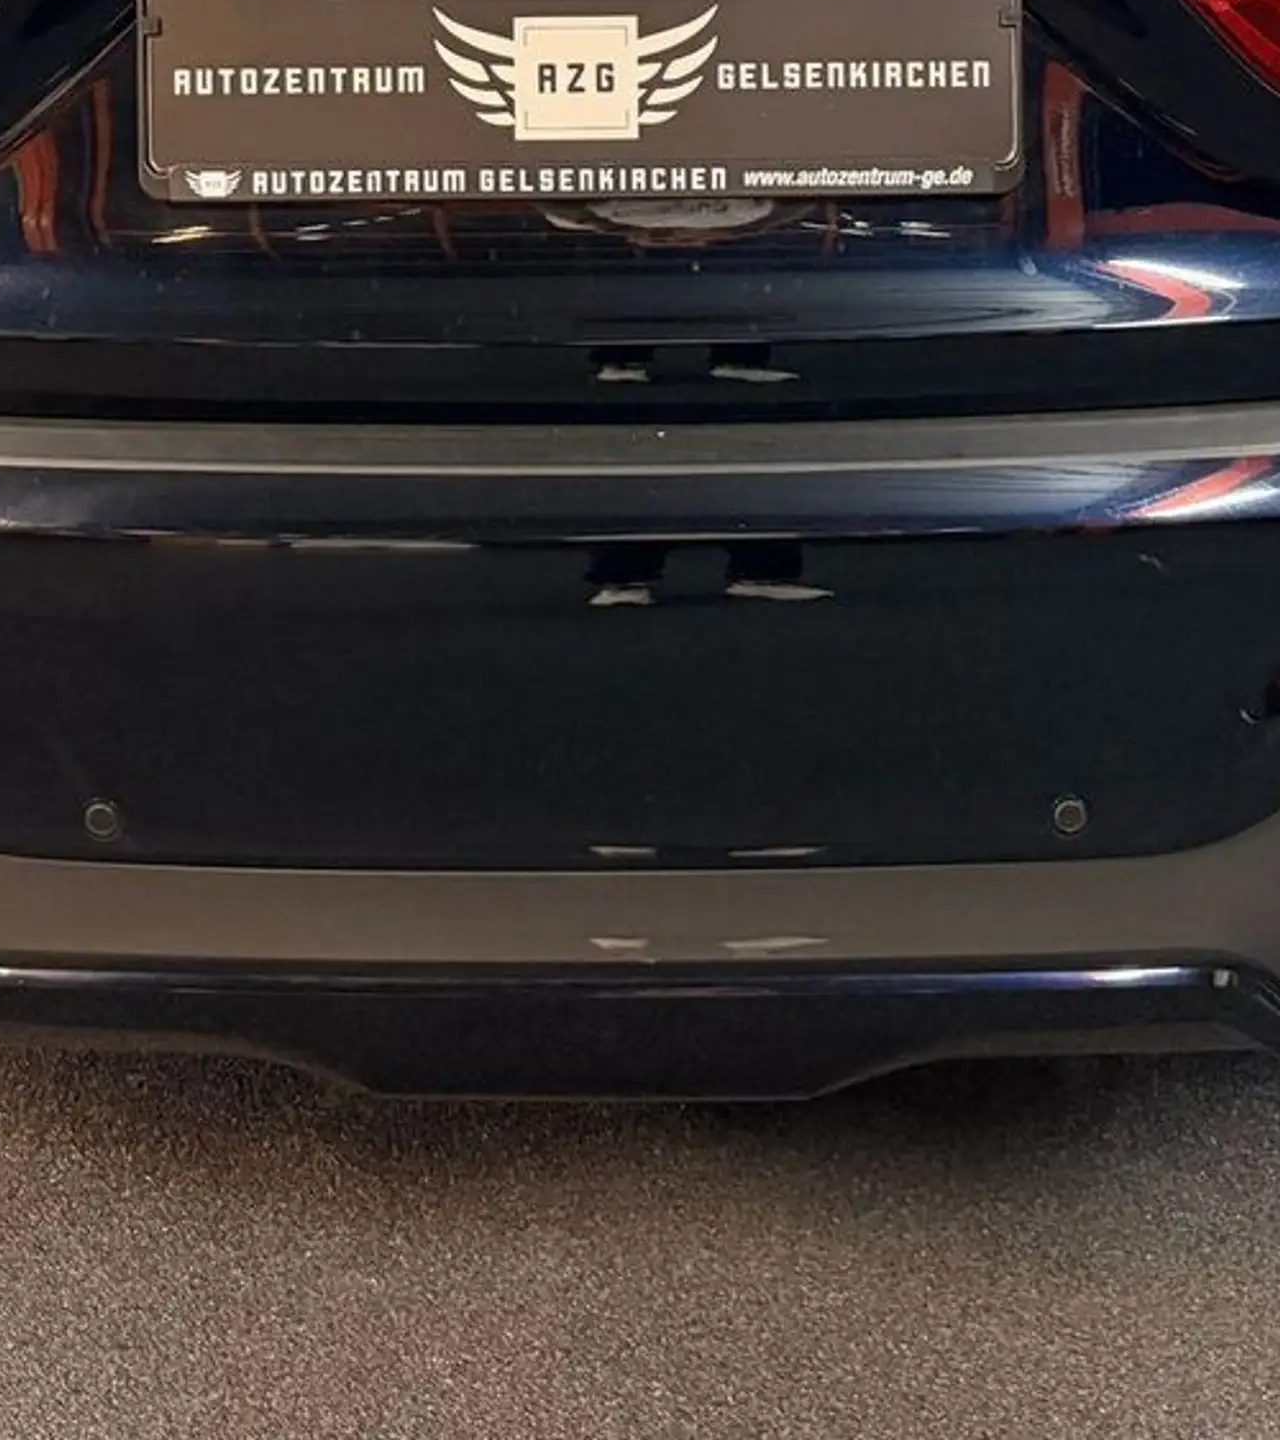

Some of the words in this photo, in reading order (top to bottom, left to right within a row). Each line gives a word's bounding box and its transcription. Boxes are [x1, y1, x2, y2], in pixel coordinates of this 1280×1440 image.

[173, 66, 425, 96] AUTOZENTRUM
[538, 63, 617, 94] AZG
[717, 60, 992, 90] GELSENKIRCHEN
[252, 168, 465, 195] AUTOZENTRUM
[479, 167, 727, 194] GELSENKIRCHEN
[743, 166, 974, 189] www.autozentrum-ge.de
